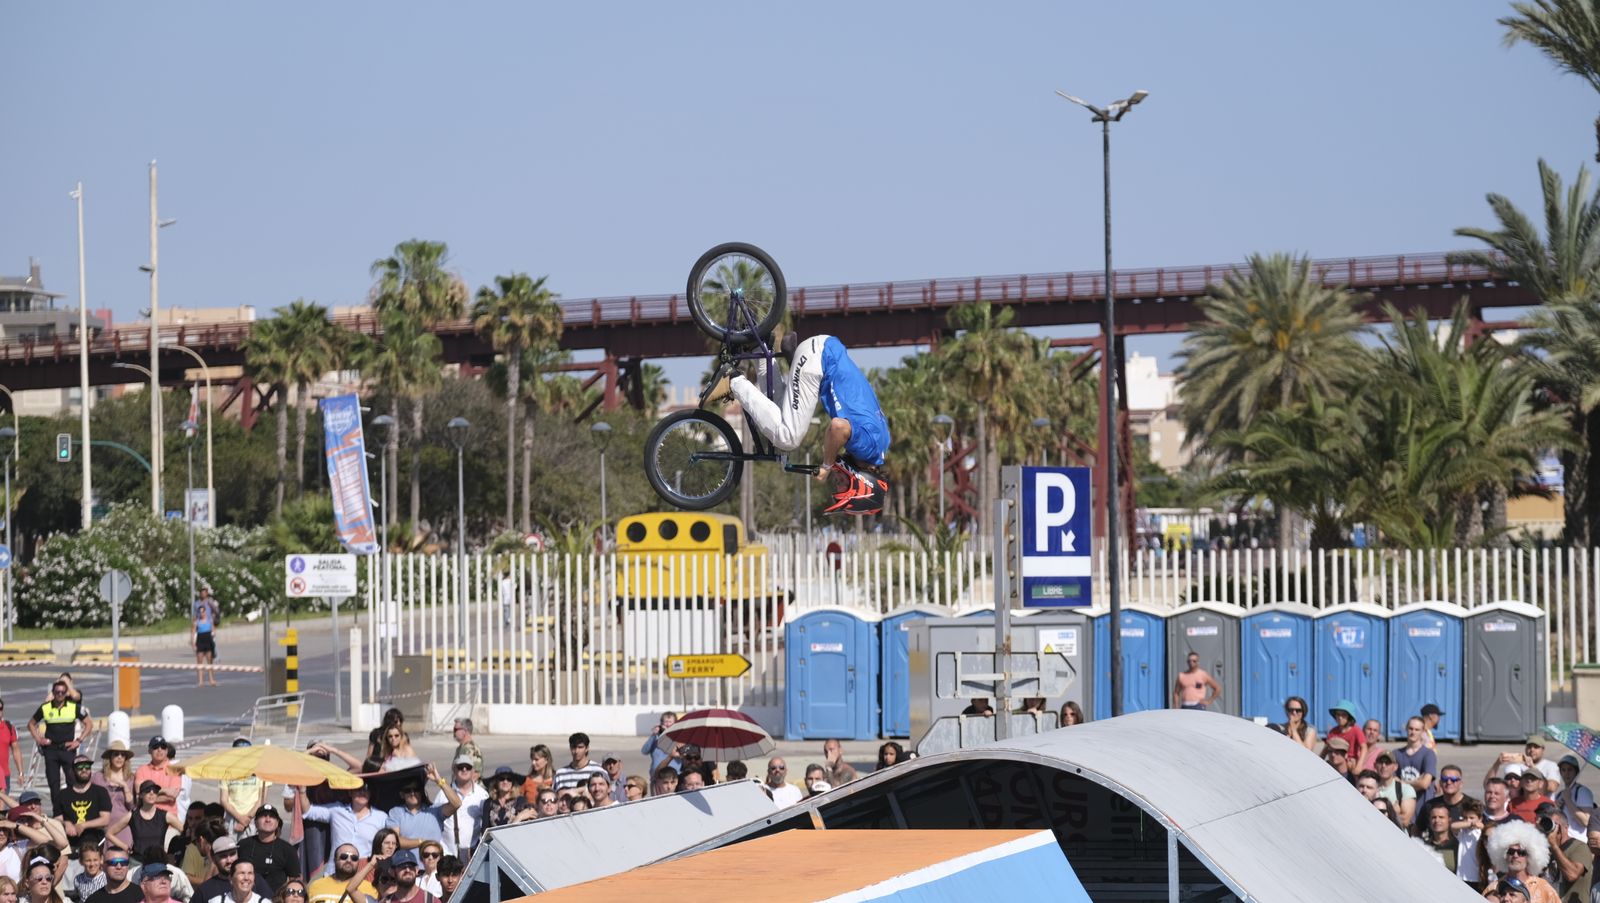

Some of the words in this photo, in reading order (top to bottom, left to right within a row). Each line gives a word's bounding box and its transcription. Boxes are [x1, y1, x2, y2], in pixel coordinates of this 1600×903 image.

[1035, 472, 1076, 552] P
[1042, 585, 1063, 595] LIBRE
[687, 666, 715, 674] FERRY
